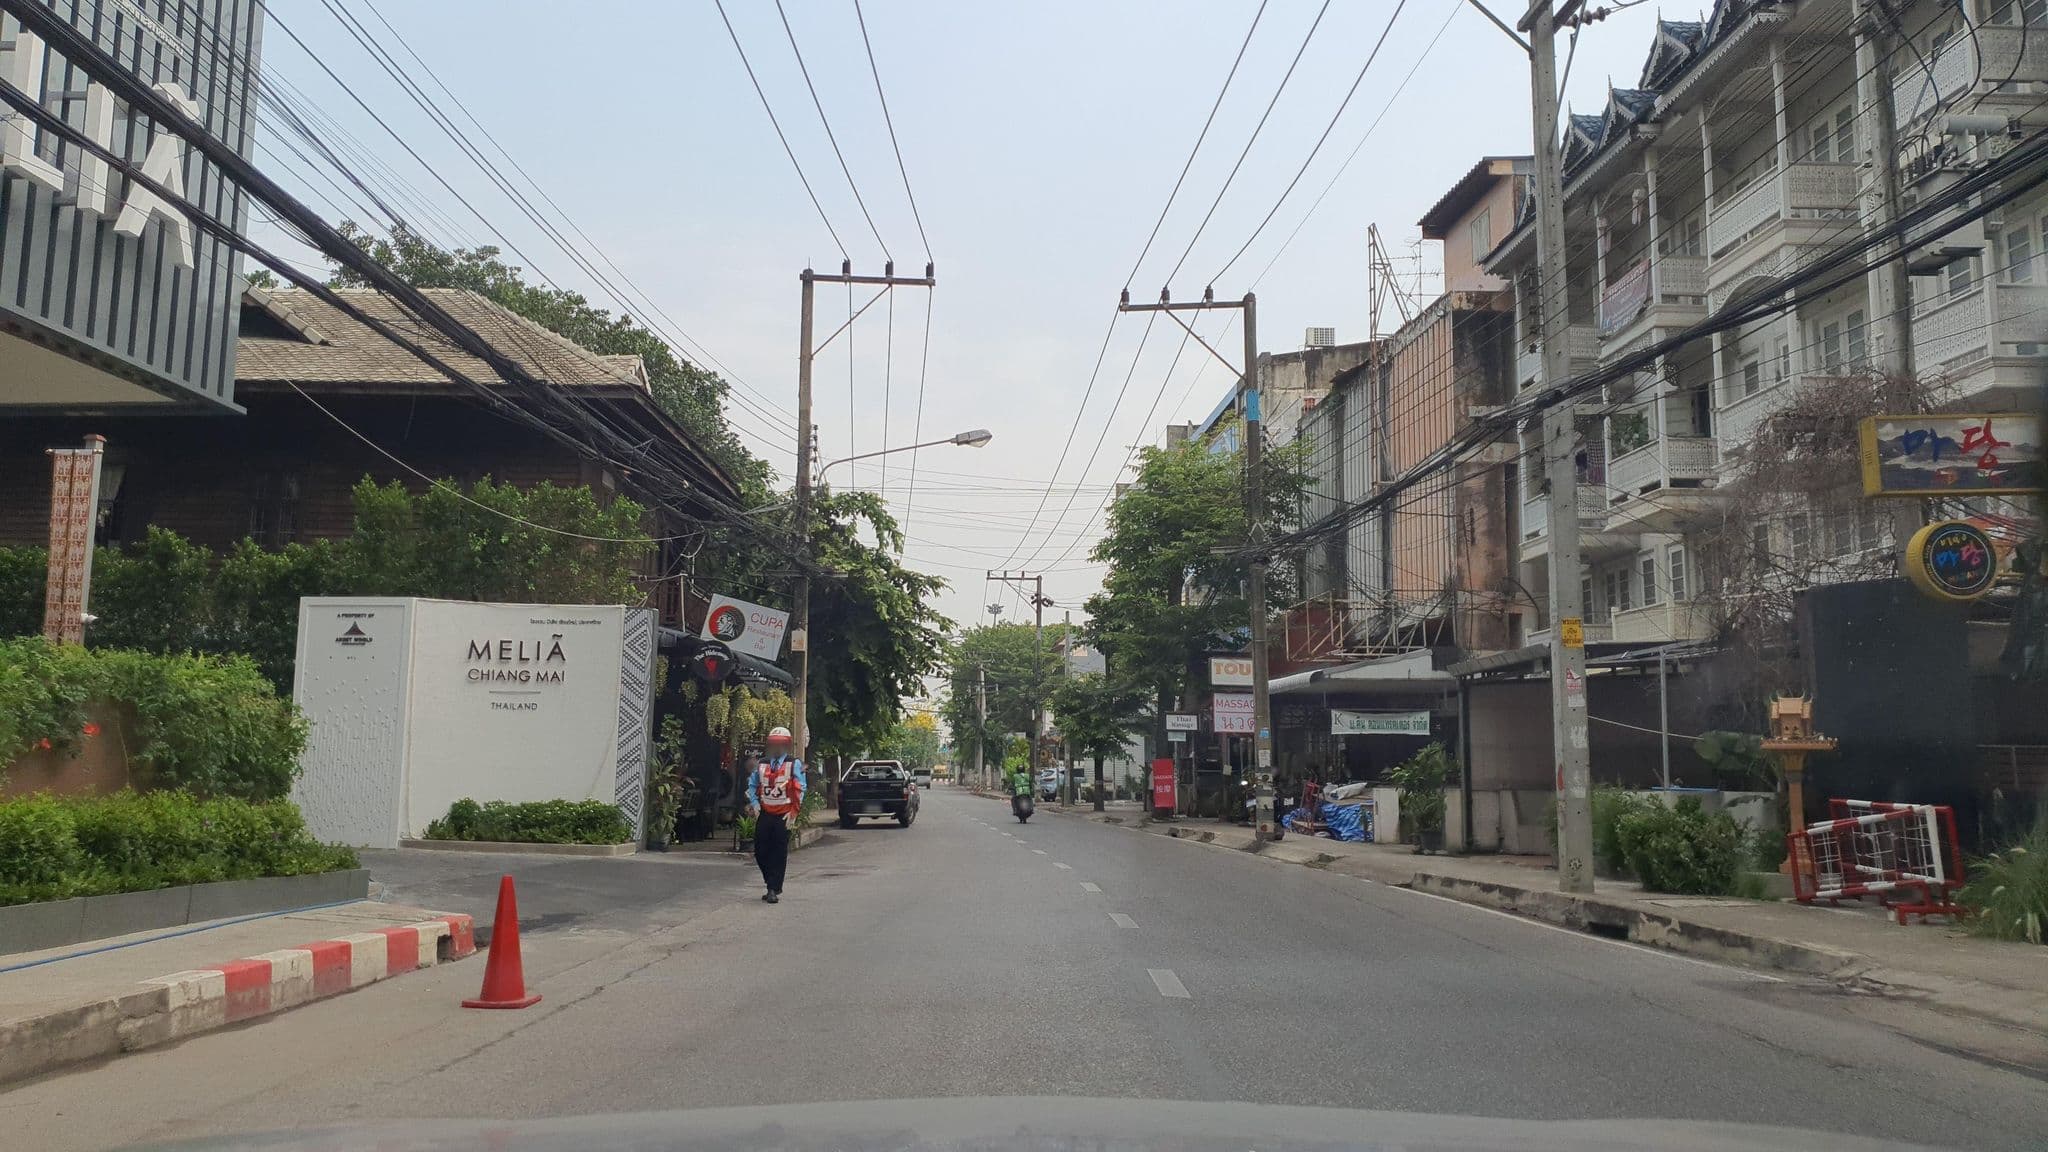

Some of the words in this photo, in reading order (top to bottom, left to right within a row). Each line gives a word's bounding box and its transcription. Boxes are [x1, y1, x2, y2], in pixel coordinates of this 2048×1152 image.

[751, 612, 784, 630] CUPA
[468, 633, 566, 661] MELIÃ
[468, 668, 531, 682] CHIANG
[536, 670, 565, 682] MAI
[491, 702, 538, 711] THAILAND
